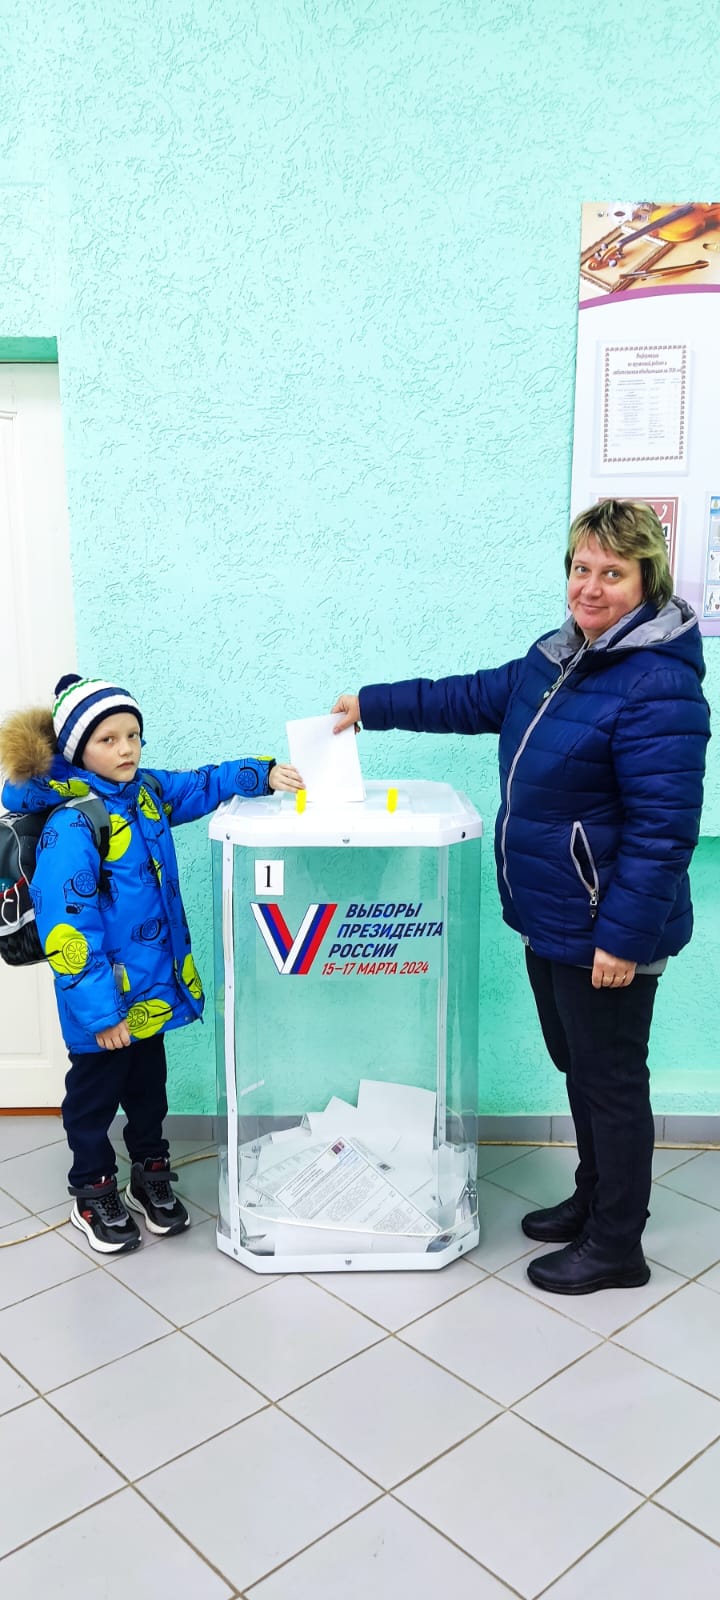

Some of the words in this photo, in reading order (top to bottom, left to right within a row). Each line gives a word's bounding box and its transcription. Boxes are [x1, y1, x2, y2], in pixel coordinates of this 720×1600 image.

[263, 864, 273, 888] 1
[345, 903, 423, 918] ВЫБОРЫ
[336, 921, 444, 940] ПРЕЗИДЕНТА
[328, 943, 399, 958] РОССИИ
[356, 962, 398, 976] МАРТА
[400, 961, 429, 975] 2024
